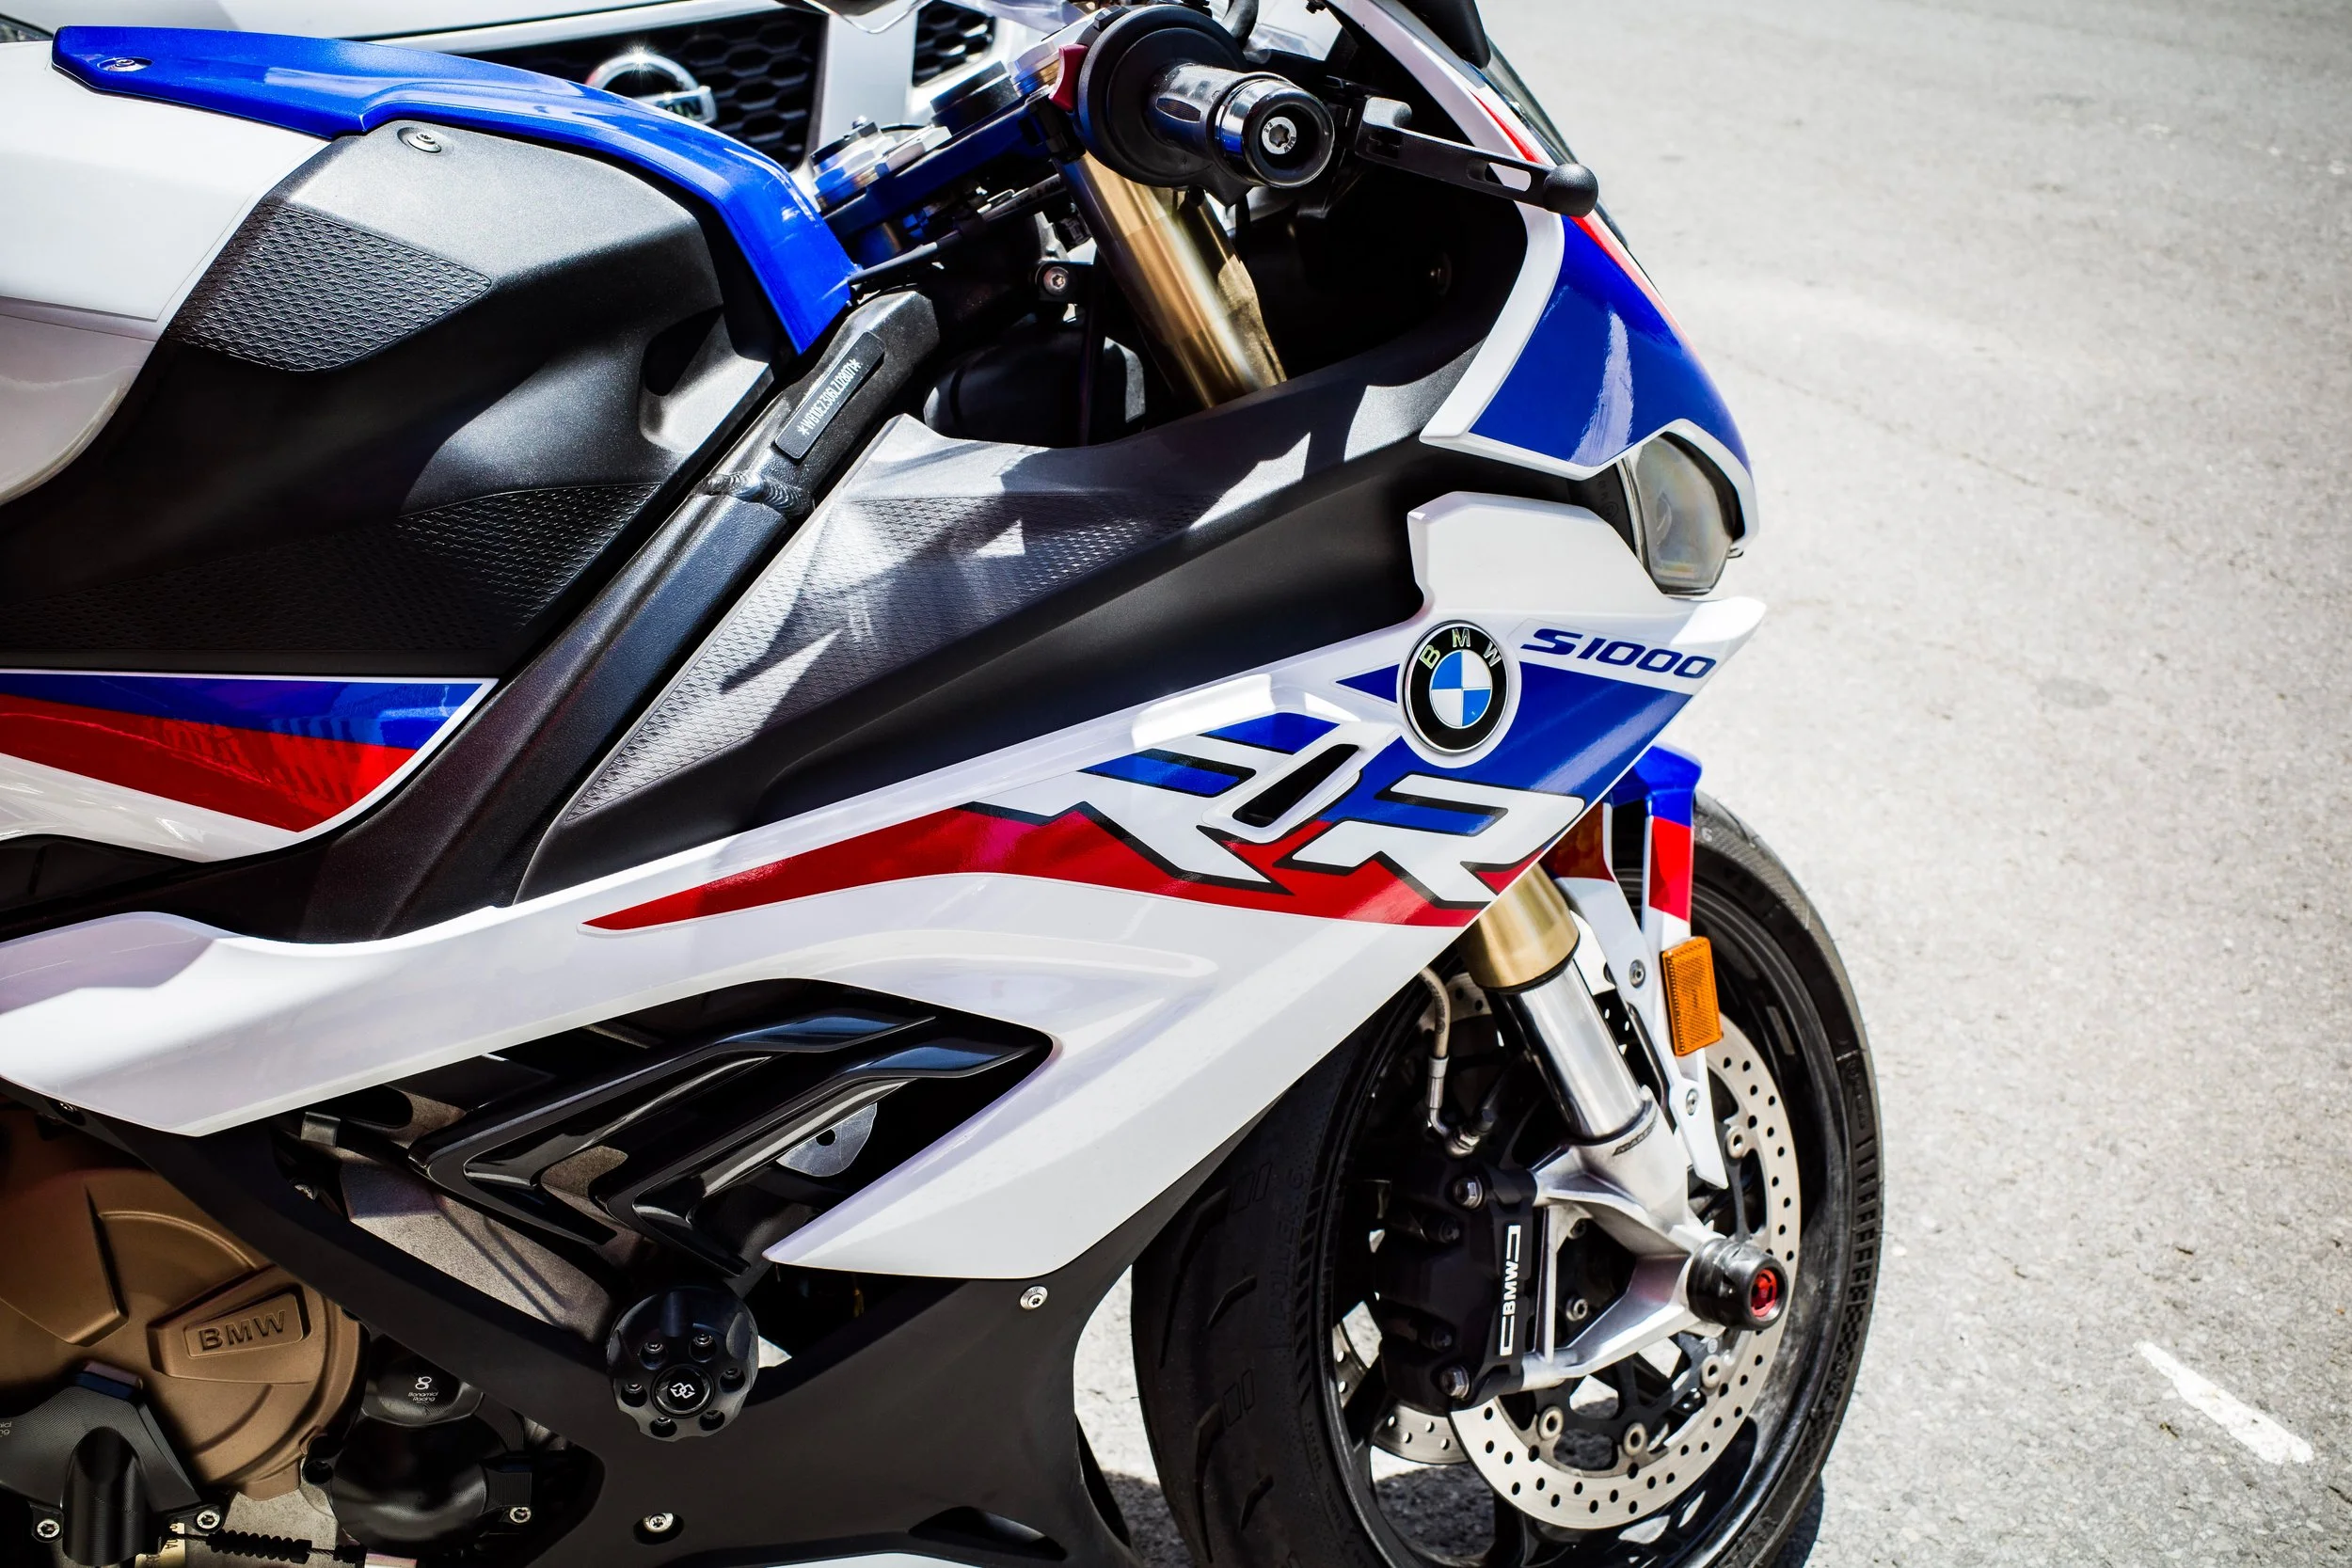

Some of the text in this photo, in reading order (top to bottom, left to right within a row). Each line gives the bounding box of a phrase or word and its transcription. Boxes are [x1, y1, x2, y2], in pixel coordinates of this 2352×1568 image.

[1419, 627, 1502, 670] BMW
[1502, 1260, 1519, 1316] BMW
[199, 1309, 286, 1352] BMW
